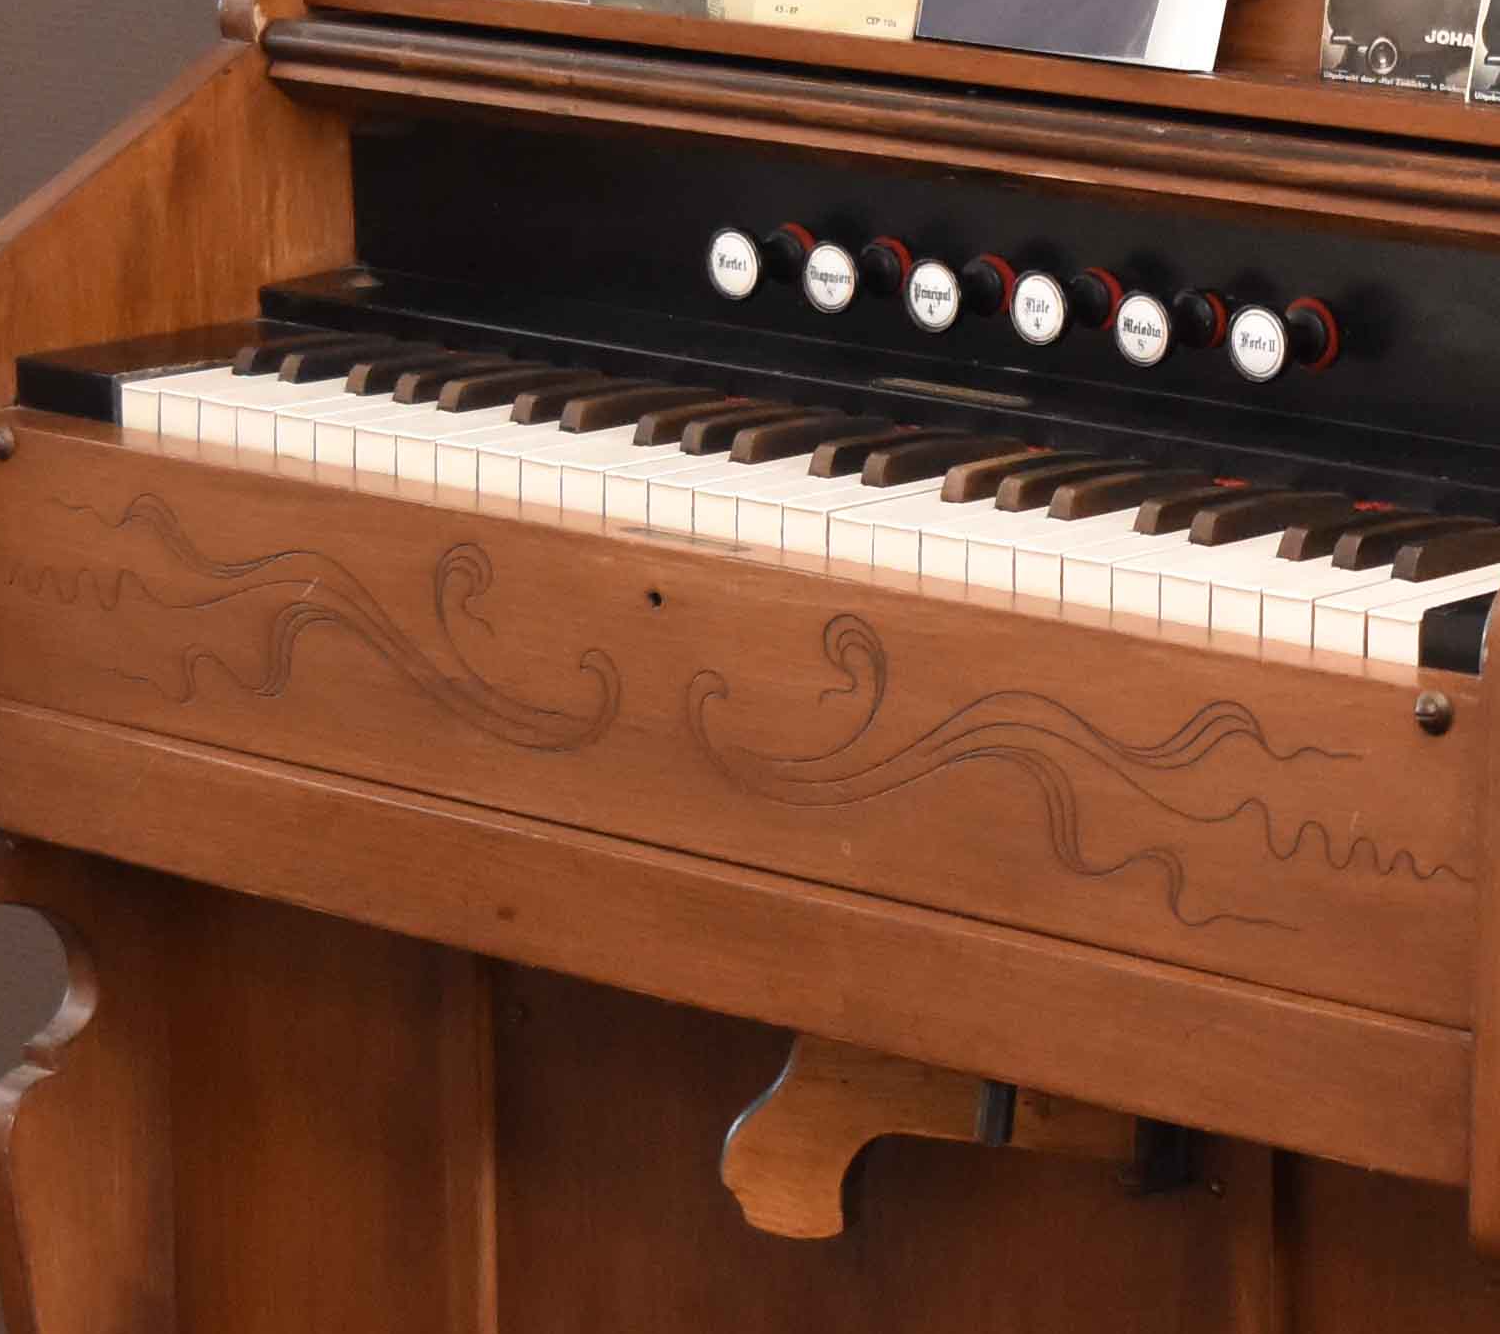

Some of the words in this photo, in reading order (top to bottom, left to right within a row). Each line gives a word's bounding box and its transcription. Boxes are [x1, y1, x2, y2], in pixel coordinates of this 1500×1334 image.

[1423, 29, 1474, 48] JOHA
[913, 282, 952, 309] Principal
[1121, 317, 1162, 339] Melodia
